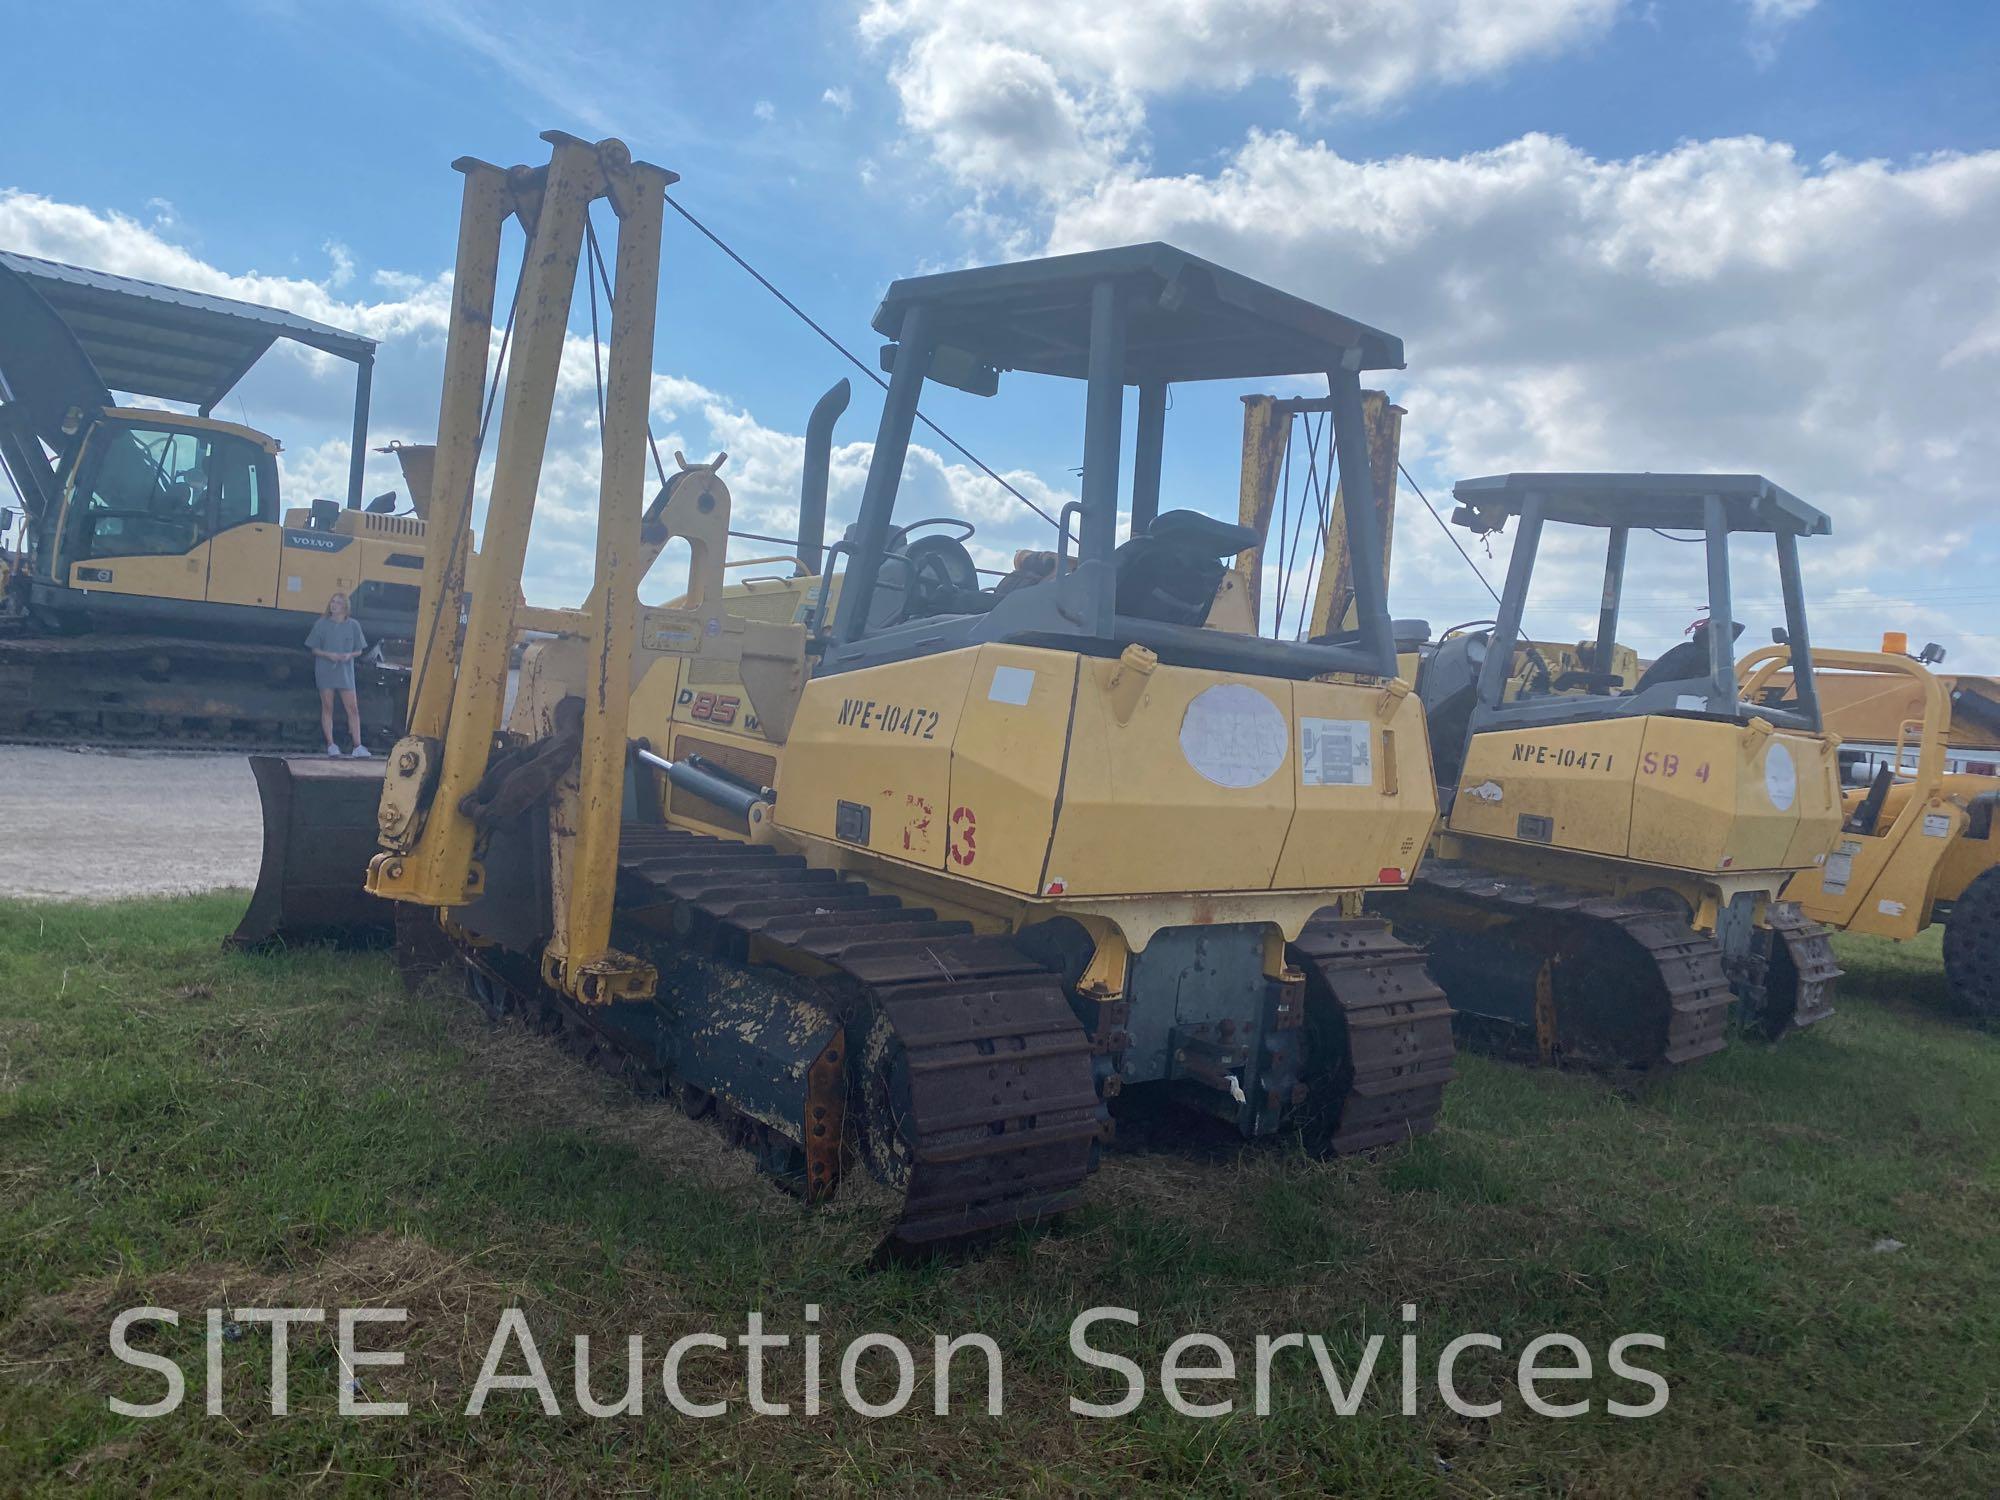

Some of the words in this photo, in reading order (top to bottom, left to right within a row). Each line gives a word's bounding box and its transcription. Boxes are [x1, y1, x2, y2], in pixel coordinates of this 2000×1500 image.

[292, 536, 334, 548] VOLVO
[838, 699, 940, 740] NPE-10472
[1512, 743, 1614, 772] NPE-10471
[1643, 751, 1680, 778] SB
[1695, 761, 1711, 784] 4
